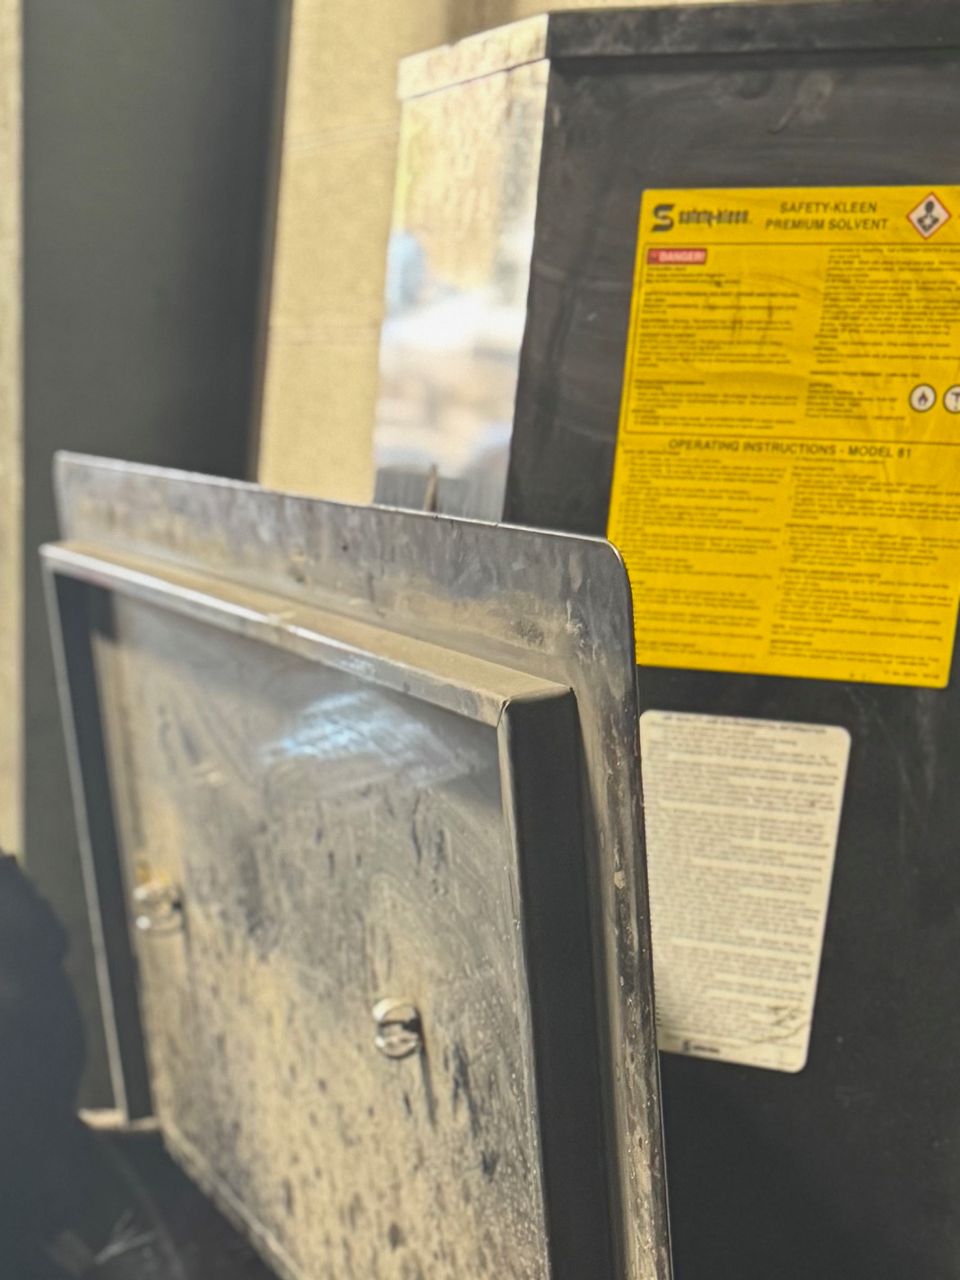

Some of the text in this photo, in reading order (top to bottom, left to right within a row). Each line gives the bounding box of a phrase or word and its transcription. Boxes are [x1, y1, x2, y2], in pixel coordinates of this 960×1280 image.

[780, 201, 877, 214] SAFETY-KLEEN
[765, 218, 888, 231] PREMIUM SOLVENT
[658, 250, 707, 263] DANGER
[668, 439, 740, 451] OPERATING
[743, 442, 837, 455] INSTRUCTIONS
[848, 445, 894, 458] MODEL
